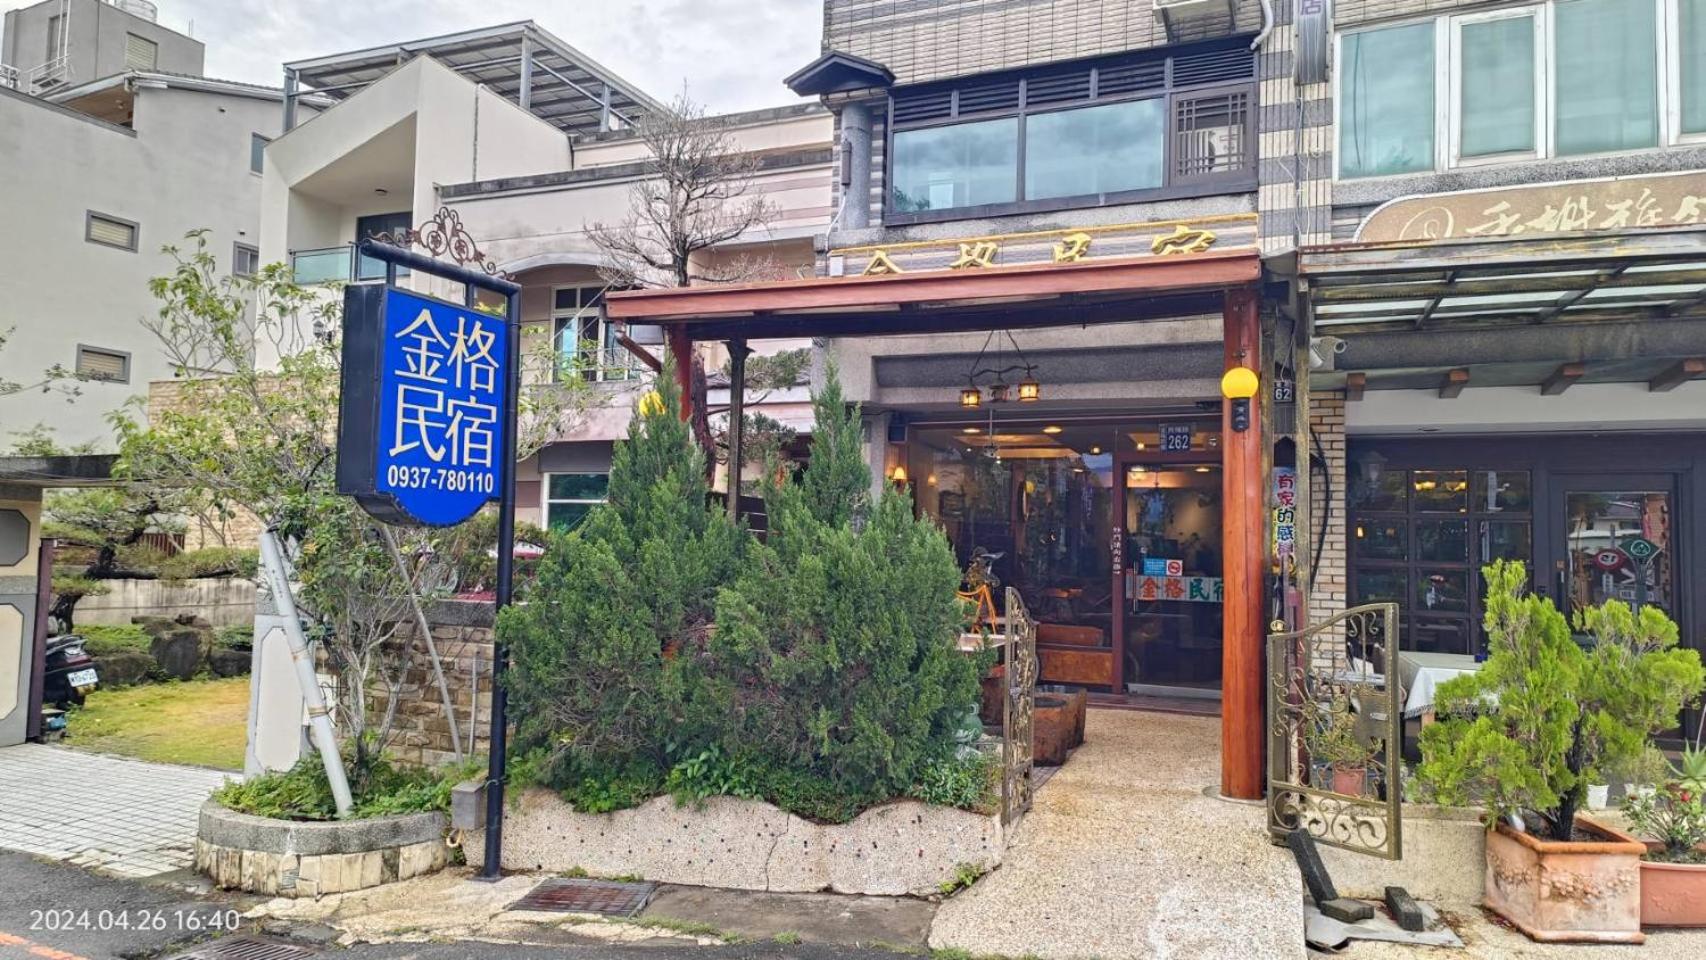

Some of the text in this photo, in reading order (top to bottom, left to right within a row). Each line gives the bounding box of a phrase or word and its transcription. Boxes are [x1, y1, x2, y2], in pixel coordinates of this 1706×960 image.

[394, 308, 500, 394] 金格
[389, 383, 498, 468] 民宿
[1168, 434, 1189, 449] 262
[387, 464, 494, 494] 0937-780110
